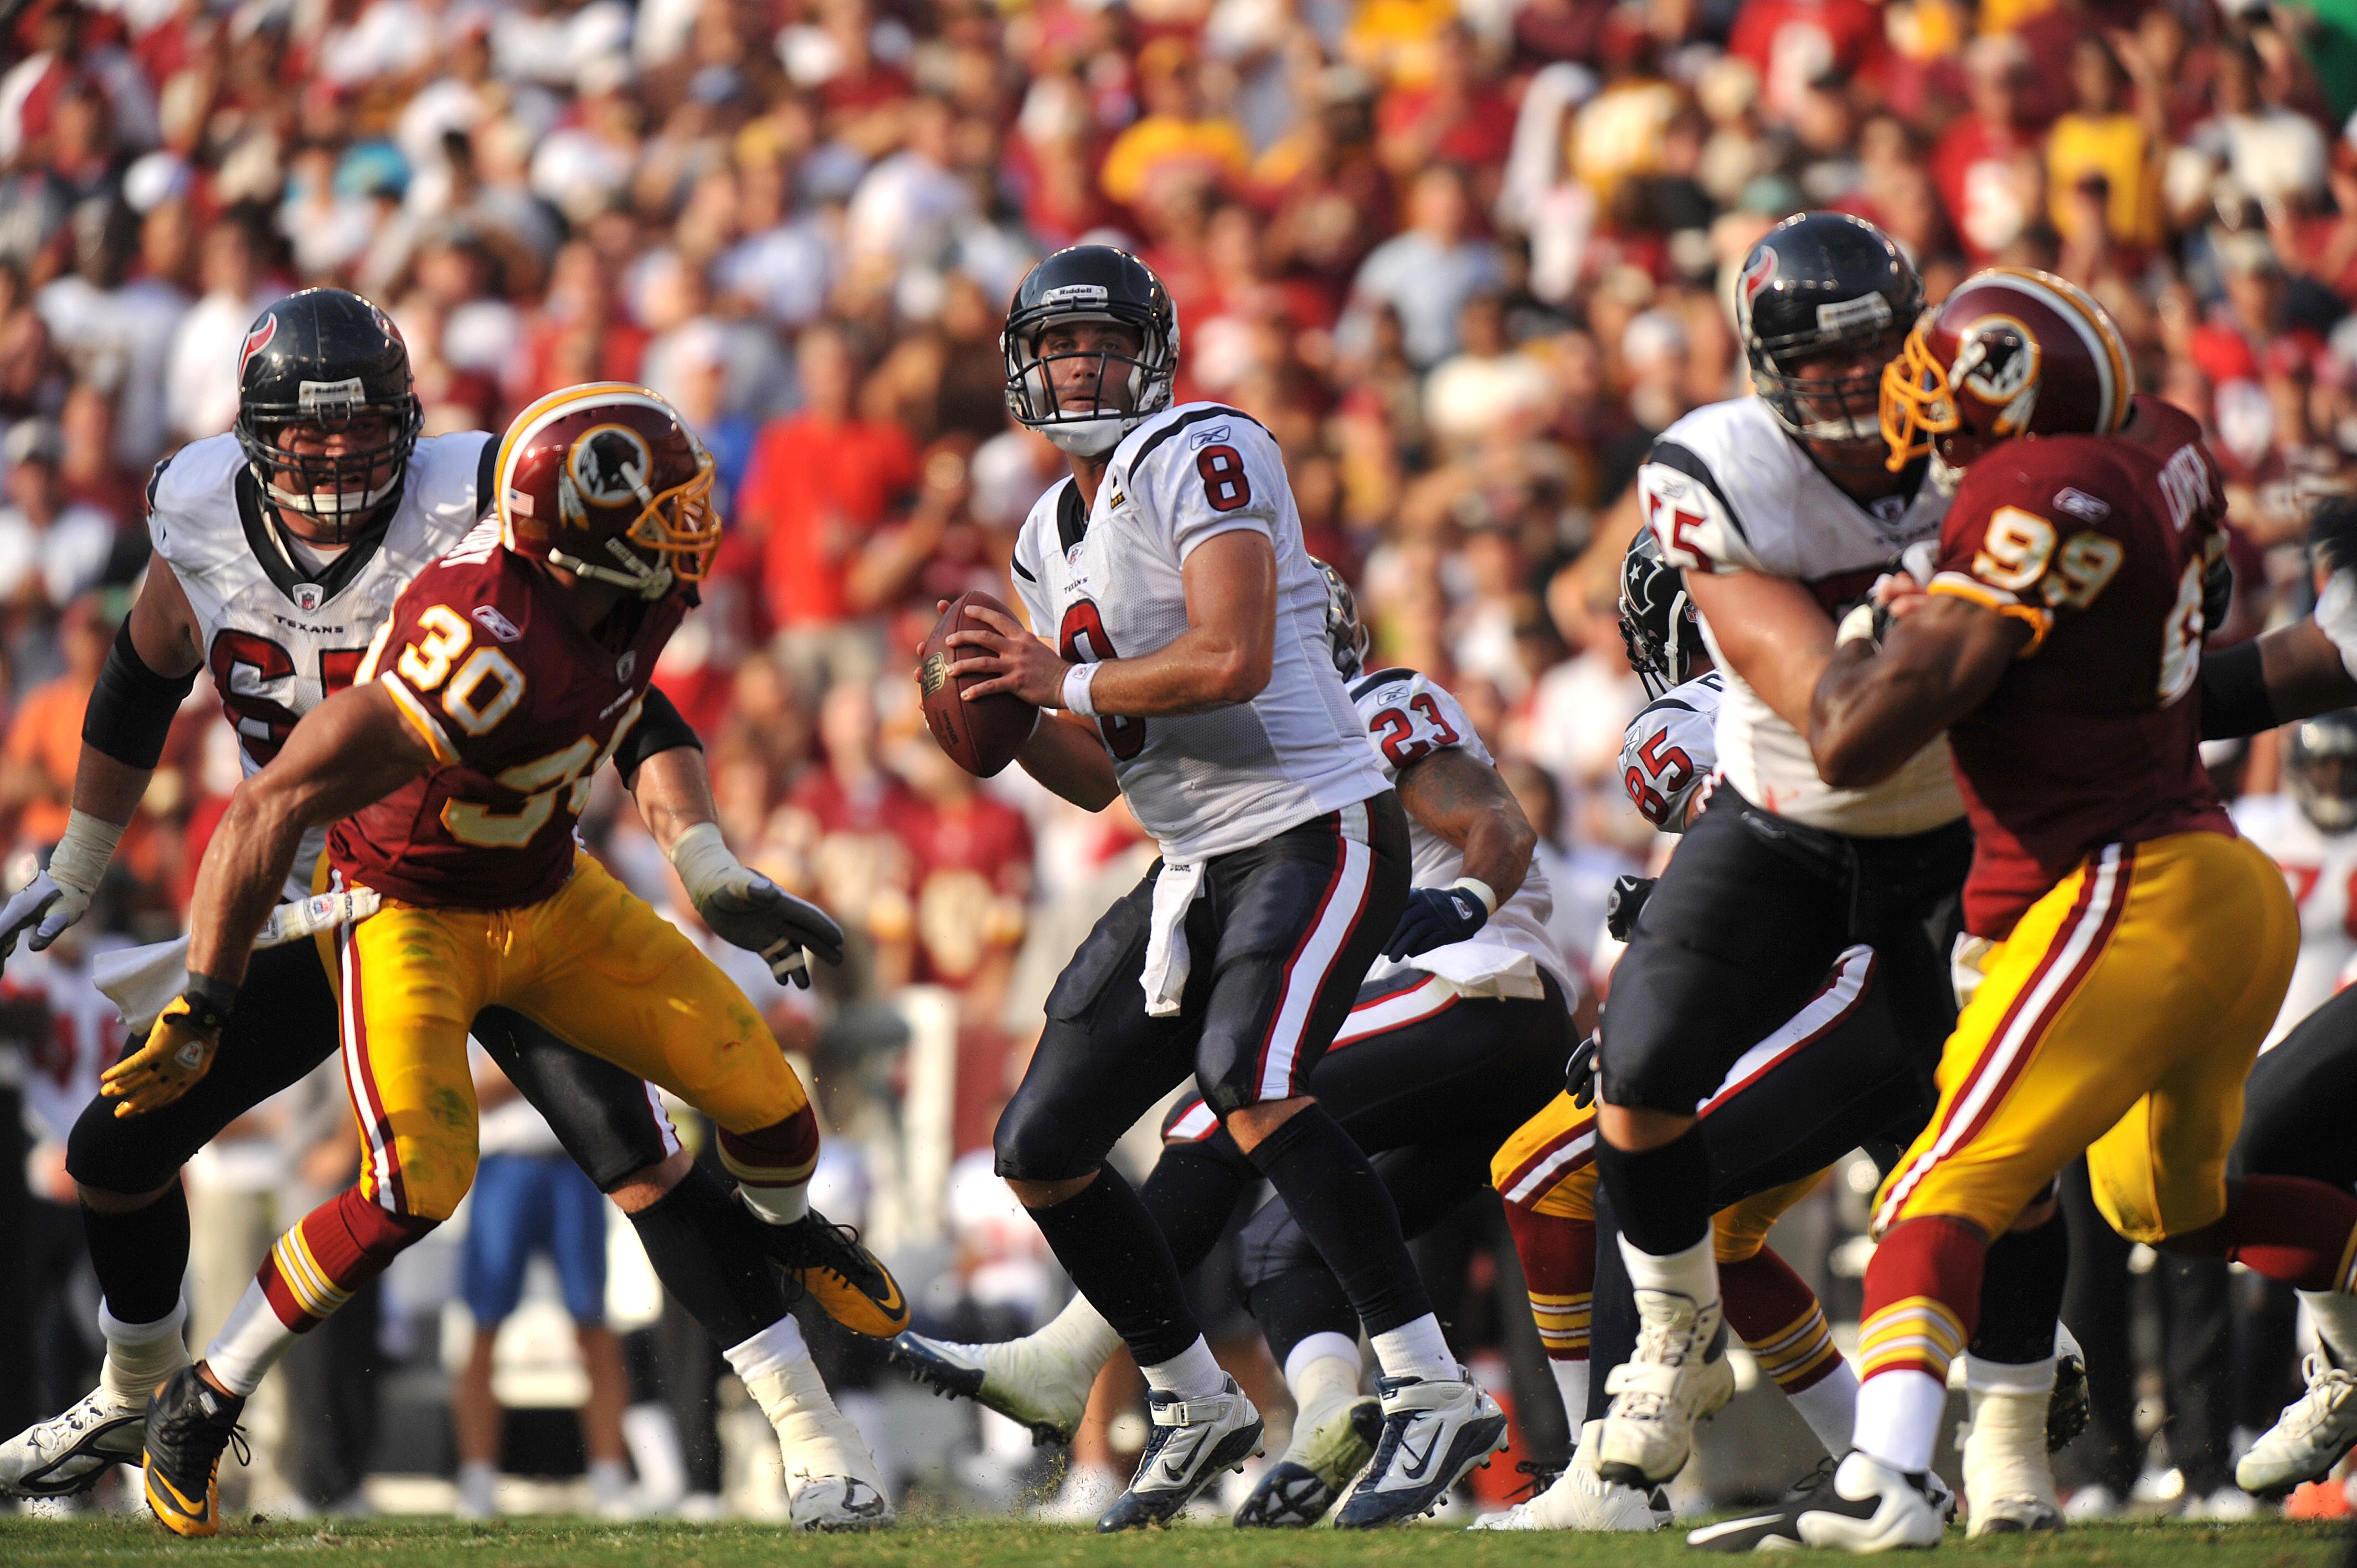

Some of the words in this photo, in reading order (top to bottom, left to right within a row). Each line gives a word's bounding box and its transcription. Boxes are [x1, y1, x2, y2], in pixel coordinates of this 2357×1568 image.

[1196, 445, 1251, 512] 8
[1970, 504, 2125, 608] 99
[274, 614, 344, 633] TEXANS
[398, 604, 526, 735] 30
[930, 657, 941, 687] NFL
[1369, 692, 1460, 768] 23
[1625, 725, 1694, 825] 85
